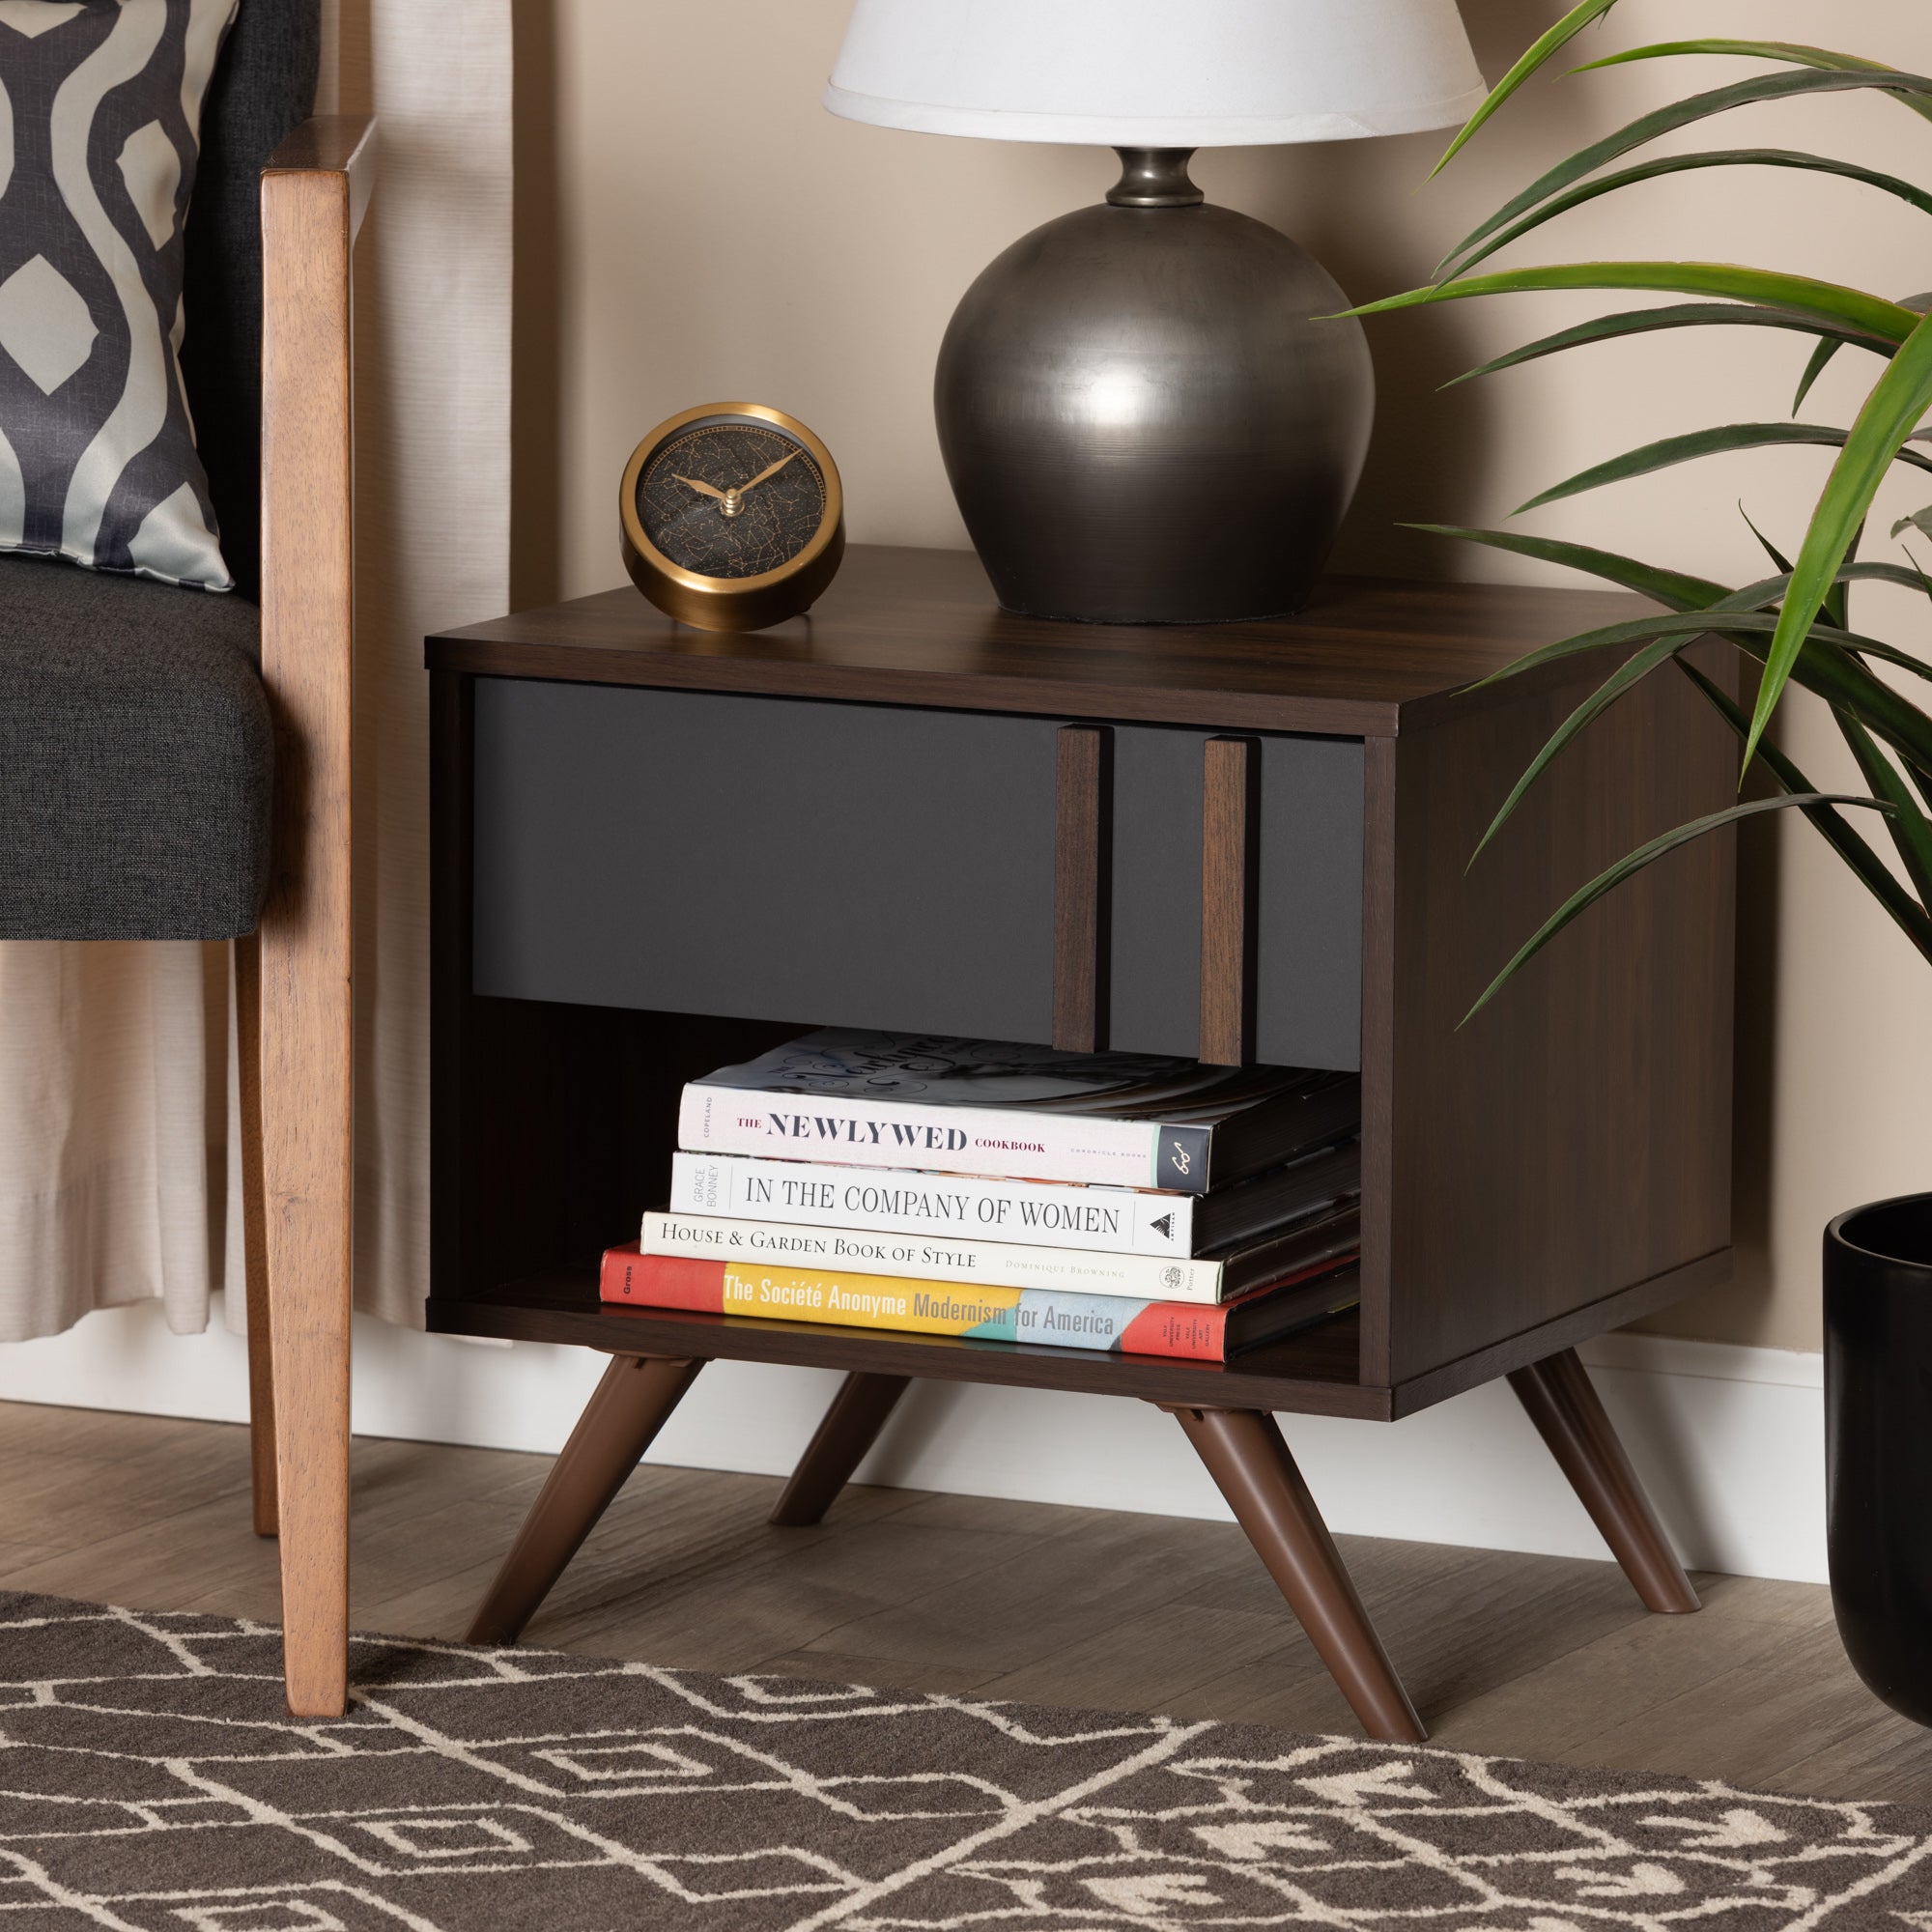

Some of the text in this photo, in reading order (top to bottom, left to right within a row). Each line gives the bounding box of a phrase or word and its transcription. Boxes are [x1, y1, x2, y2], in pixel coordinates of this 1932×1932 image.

[703, 1096, 713, 1138] COPELAND
[737, 1113, 1046, 1153] THE NEWLYWED COOKBOOK
[1070, 1148, 1117, 1156] CHRONICLE
[693, 1168, 705, 1203] GRACE
[706, 1165, 719, 1208] BONNEY
[746, 1177, 1121, 1234] IN THE COMPANY OF WOMEN
[729, 1231, 744, 1246] &
[623, 1265, 633, 1294] Gross
[1186, 1267, 1195, 1291] Potter
[724, 1274, 1114, 1335] The Société Anonyme Modernism for America
